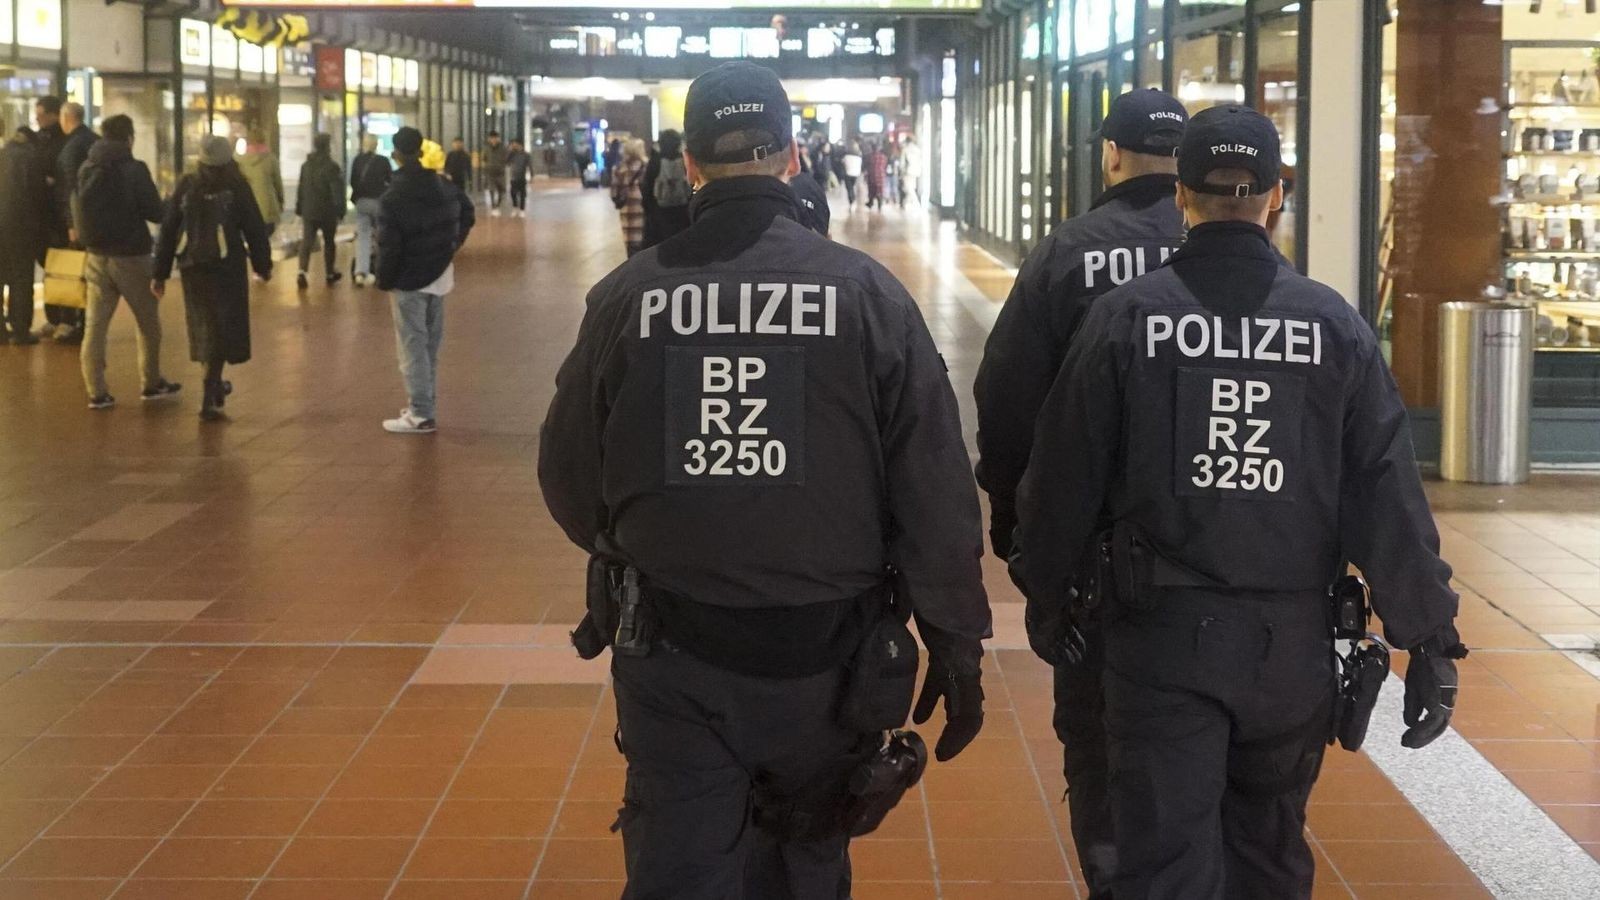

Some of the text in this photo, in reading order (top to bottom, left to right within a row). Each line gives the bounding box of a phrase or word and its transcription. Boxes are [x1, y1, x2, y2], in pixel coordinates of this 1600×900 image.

[714, 103, 764, 119] POLIZEI
[1149, 111, 1183, 122] POLIZEI
[1210, 143, 1258, 157] POLIZEI
[1084, 247, 1180, 288] POL
[640, 283, 837, 339] POLIZEI
[1146, 313, 1322, 365] POLIZEI
[703, 357, 767, 393] BP
[1211, 378, 1272, 414] BP
[701, 398, 768, 435] RZ
[1208, 416, 1272, 454] RZ
[683, 438, 787, 477] 3250
[1191, 453, 1285, 493] 3250
